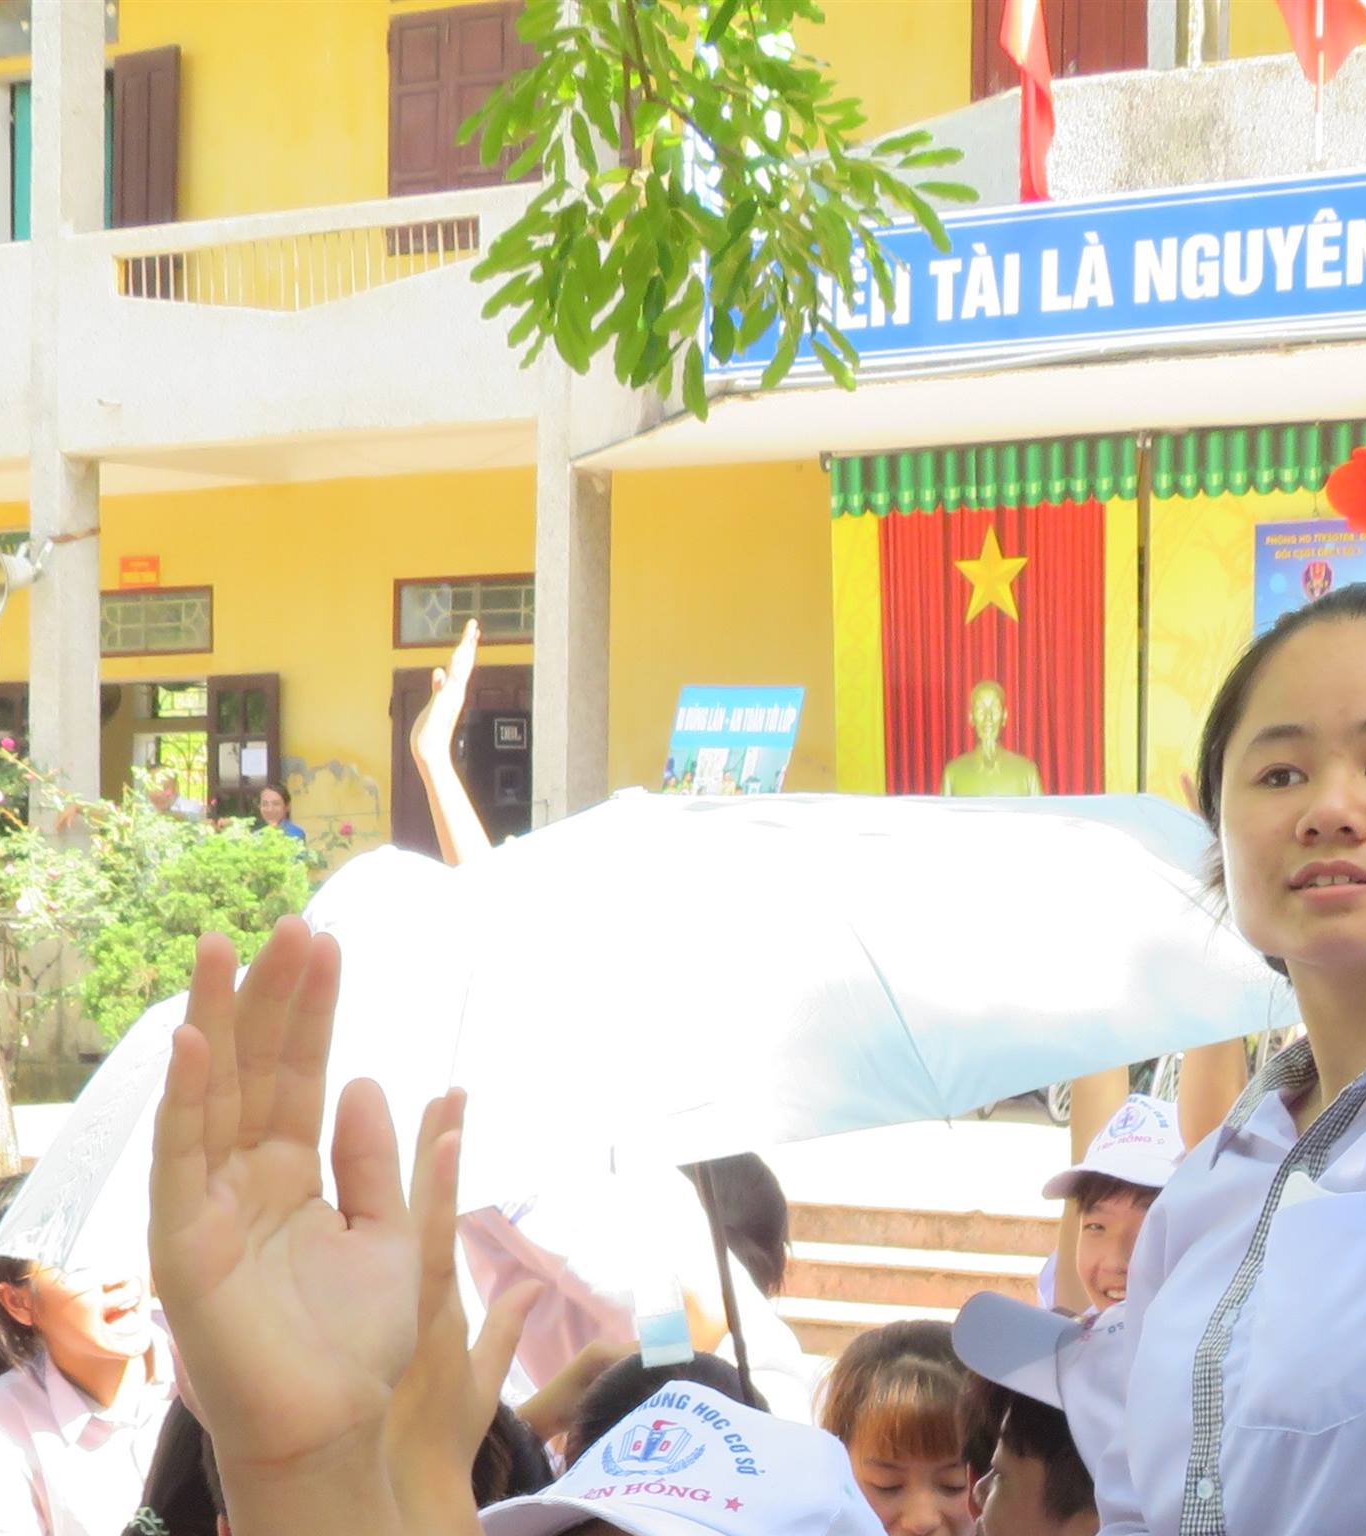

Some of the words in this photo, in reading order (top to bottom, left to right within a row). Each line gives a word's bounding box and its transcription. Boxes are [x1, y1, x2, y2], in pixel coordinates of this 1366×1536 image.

[929, 242, 1020, 321] TÀI
[1040, 231, 1114, 313] LÀ
[692, 1401, 731, 1431] HỌC
[724, 1431, 752, 1455] CƠ
